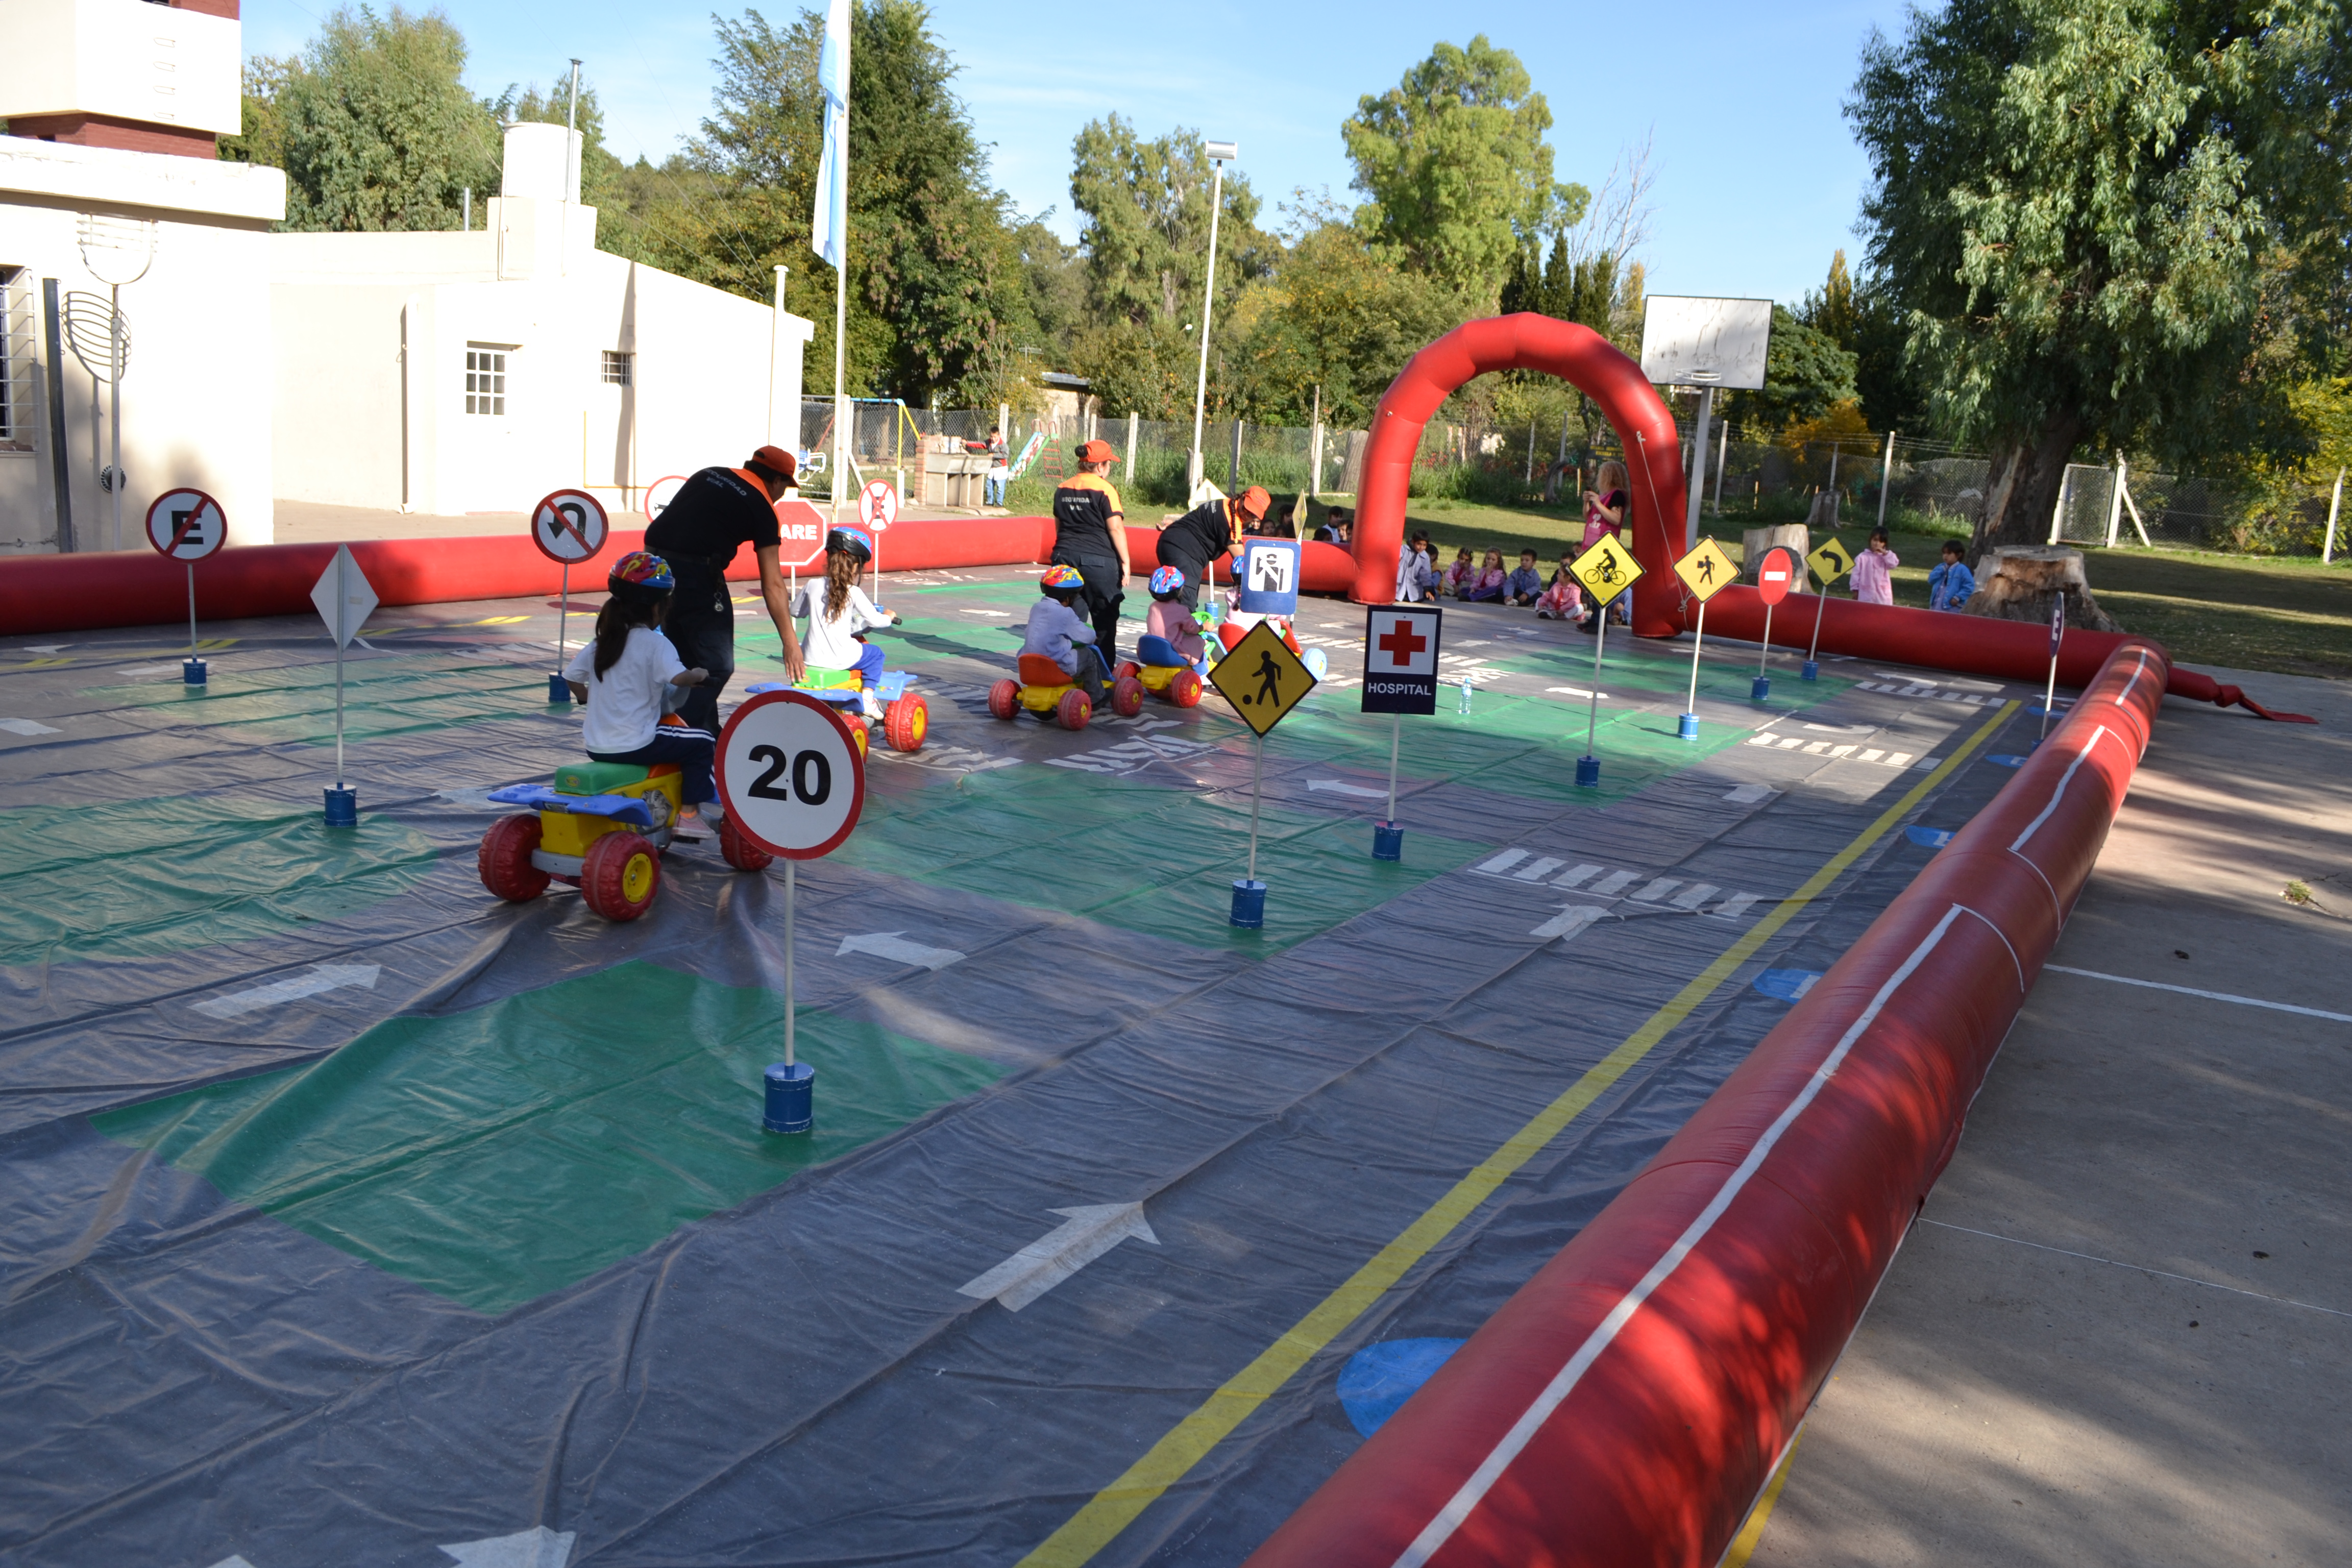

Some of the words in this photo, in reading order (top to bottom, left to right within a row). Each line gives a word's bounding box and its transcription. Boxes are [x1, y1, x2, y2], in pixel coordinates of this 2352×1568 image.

[171, 510, 204, 545] E
[780, 524, 817, 540] ARE
[2051, 609, 2061, 641] E
[1368, 682, 1431, 696] HOSPITAL
[747, 744, 831, 805] 20
